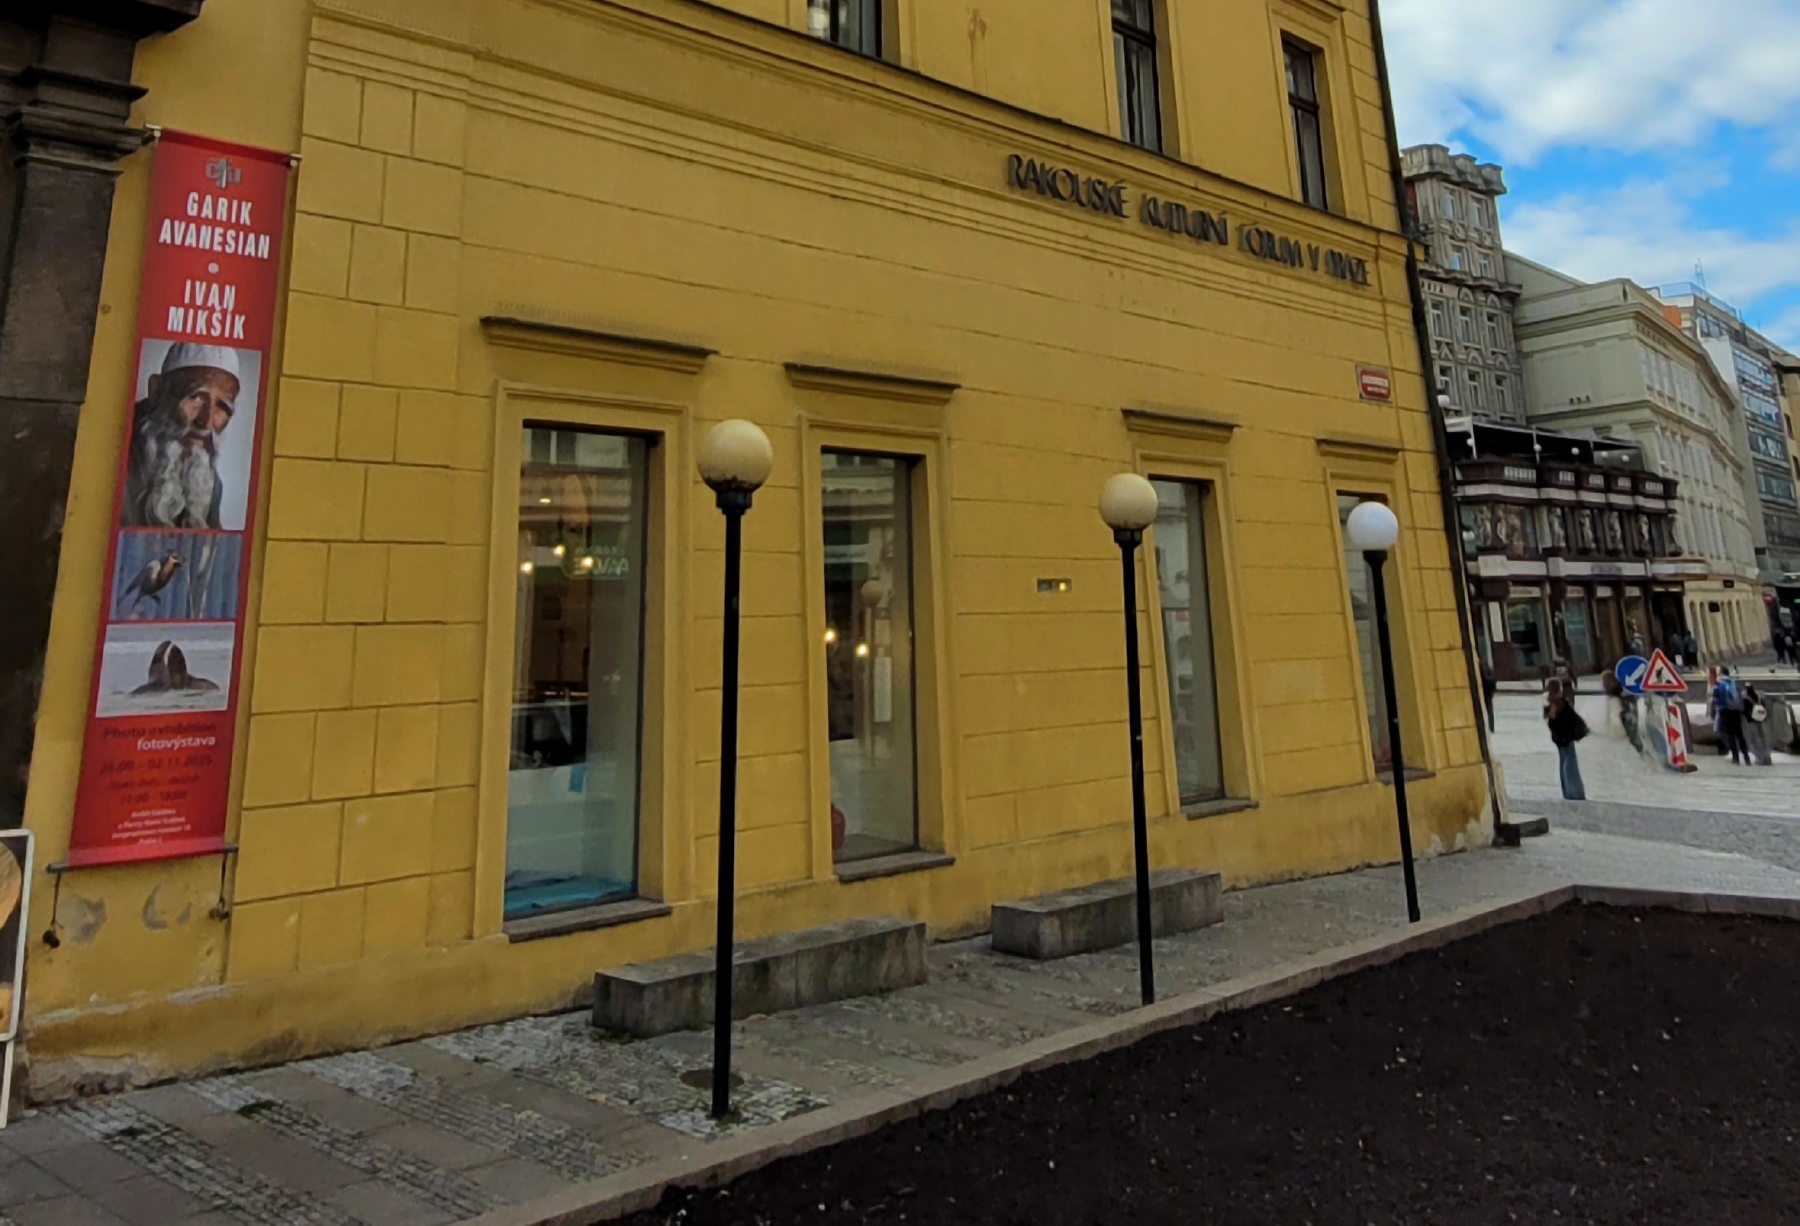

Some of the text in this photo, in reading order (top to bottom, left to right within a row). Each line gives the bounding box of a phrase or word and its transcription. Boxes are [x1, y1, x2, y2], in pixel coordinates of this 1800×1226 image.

[1007, 154, 1130, 219] RAKOUSKÉ
[186, 191, 252, 226] GARIK
[158, 218, 270, 259] AVANESIAN
[183, 279, 236, 311] IVAN
[137, 736, 216, 751] fotovýstava
